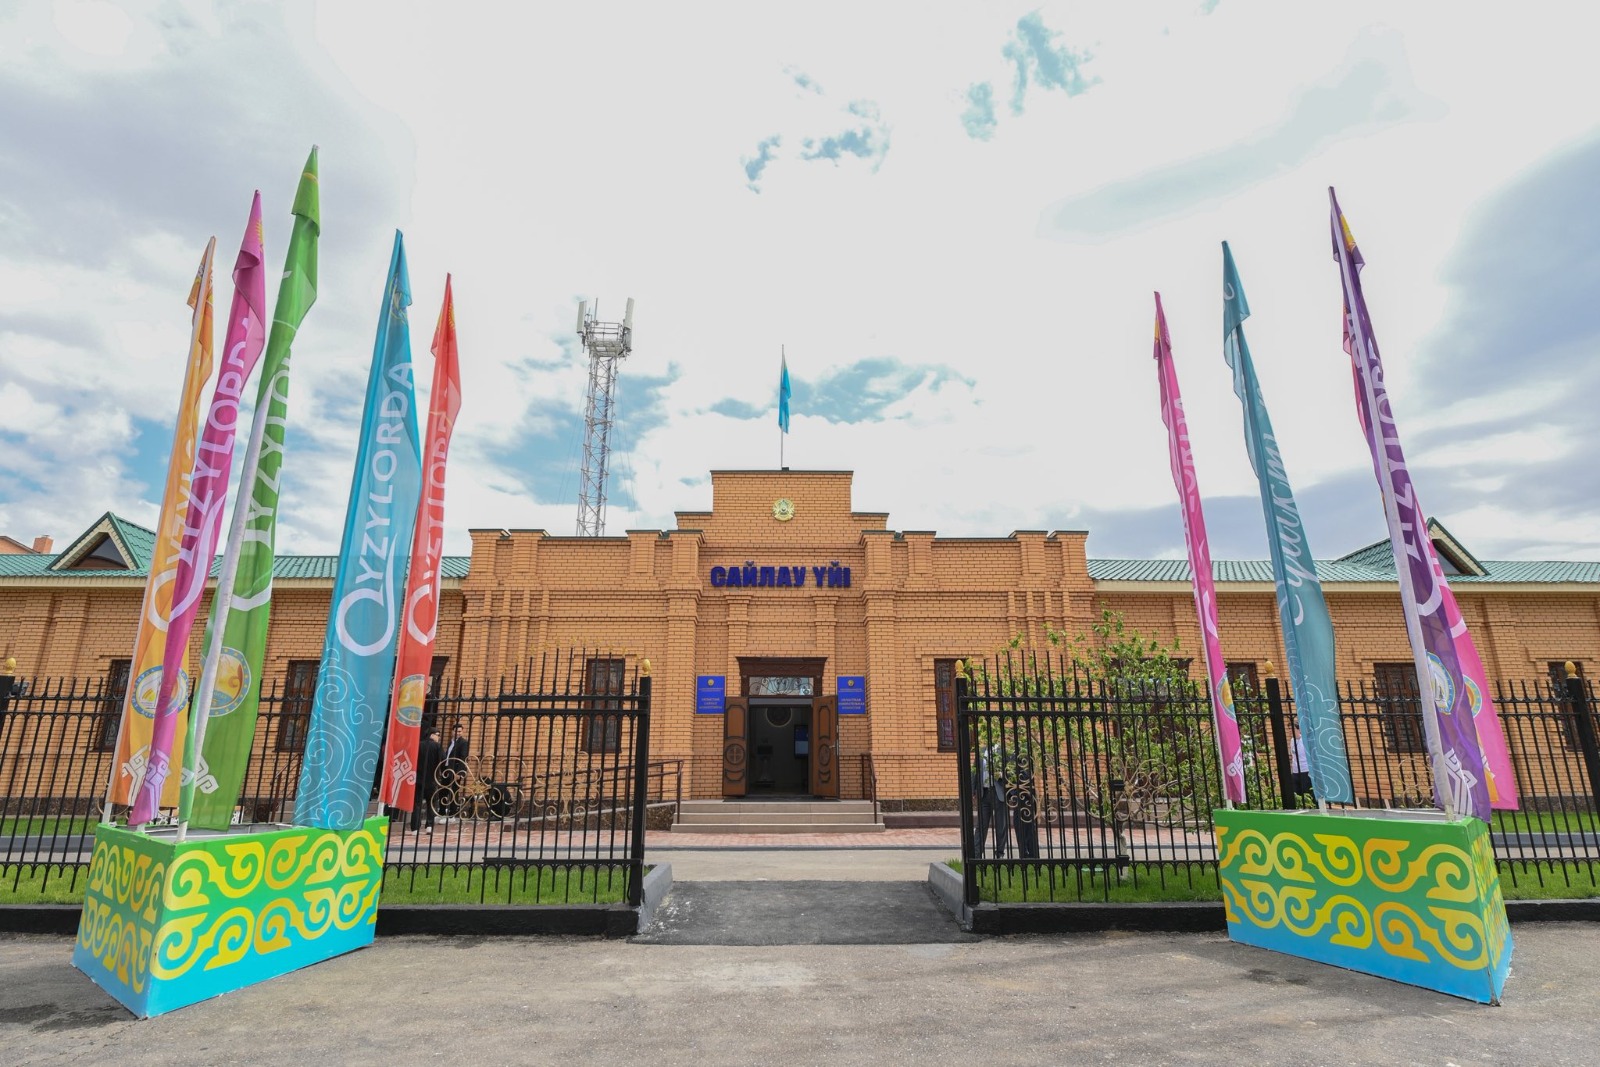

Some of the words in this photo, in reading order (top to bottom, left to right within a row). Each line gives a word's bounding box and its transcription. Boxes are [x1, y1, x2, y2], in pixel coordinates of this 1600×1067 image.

[336, 362, 414, 656] QYZYLORDA
[711, 561, 806, 588] САЙЛАУ
[813, 561, 851, 588] ҮЙІ
